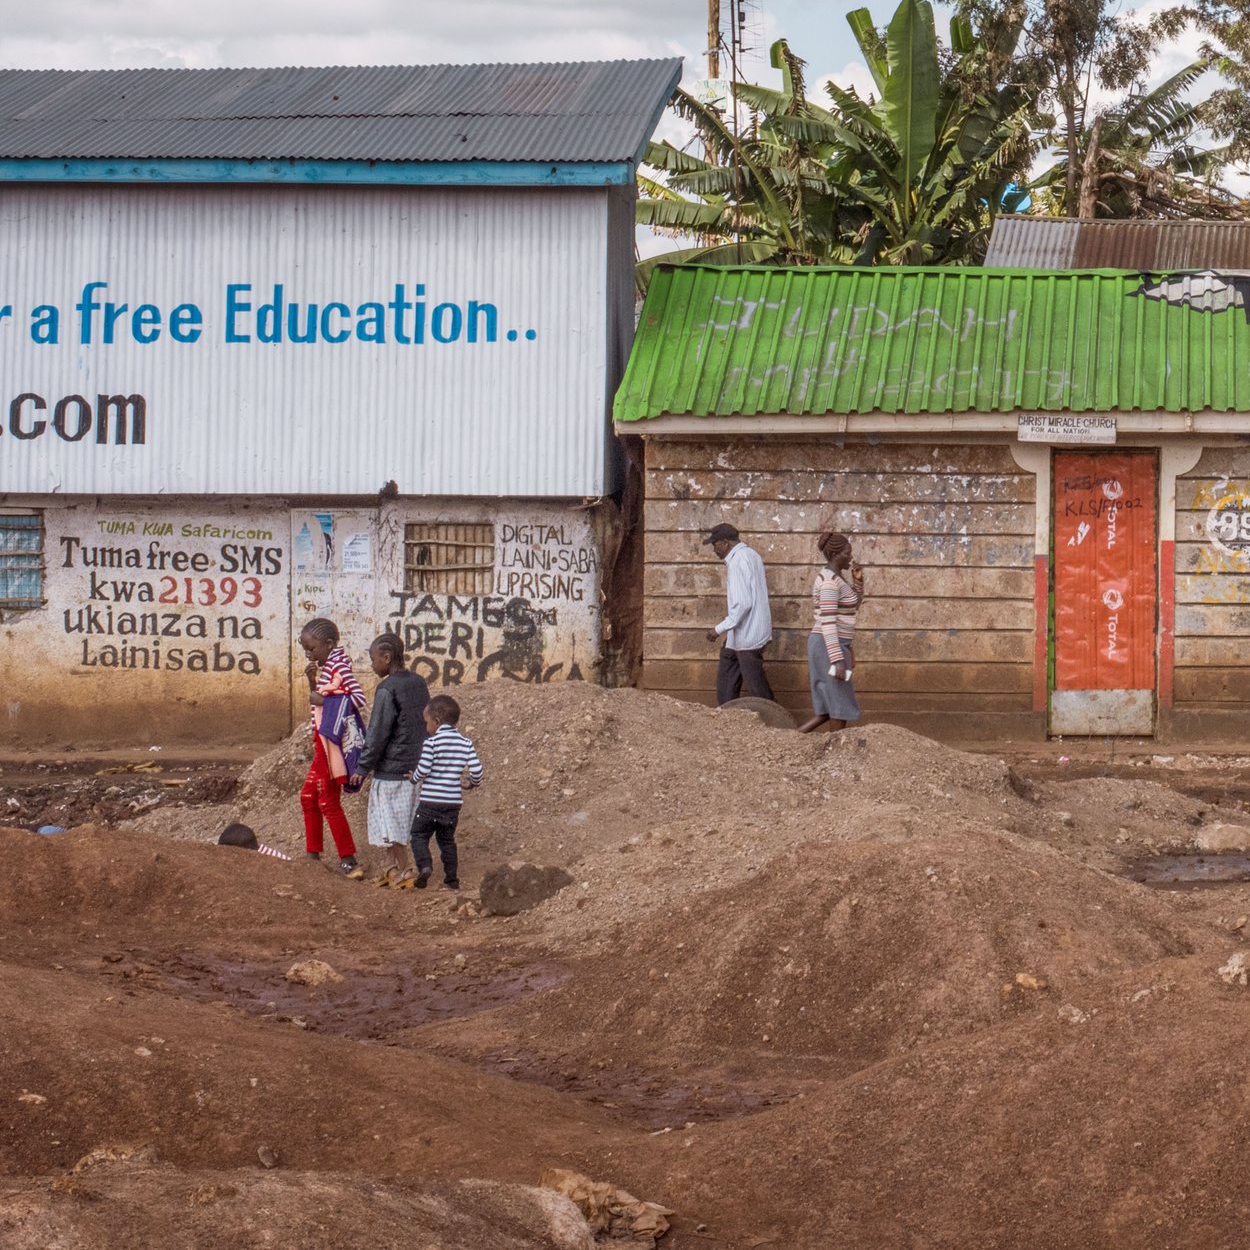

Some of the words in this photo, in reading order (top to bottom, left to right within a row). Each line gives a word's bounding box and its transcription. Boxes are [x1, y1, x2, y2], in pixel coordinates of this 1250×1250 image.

[30, 303, 59, 344] a
[76, 281, 203, 345] free
[1018, 414, 1048, 426] CHRIST
[1048, 416, 1081, 428] MIRACLE
[1083, 418, 1117, 429] CHURCH
[98, 520, 135, 535] TUMA
[142, 522, 174, 536] KWA
[181, 523, 273, 540] Safaricom
[1107, 505, 1118, 550] TOTAL
[60, 536, 142, 569] Tuma
[147, 541, 210, 572] free
[220, 544, 283, 576] SMS
[89, 571, 155, 603] kwa
[158, 575, 263, 608] 21393
[497, 568, 583, 601] UPRISING
[63, 604, 208, 637] ukianza
[217, 614, 264, 640] na
[1108, 613, 1119, 660] TOTAL
